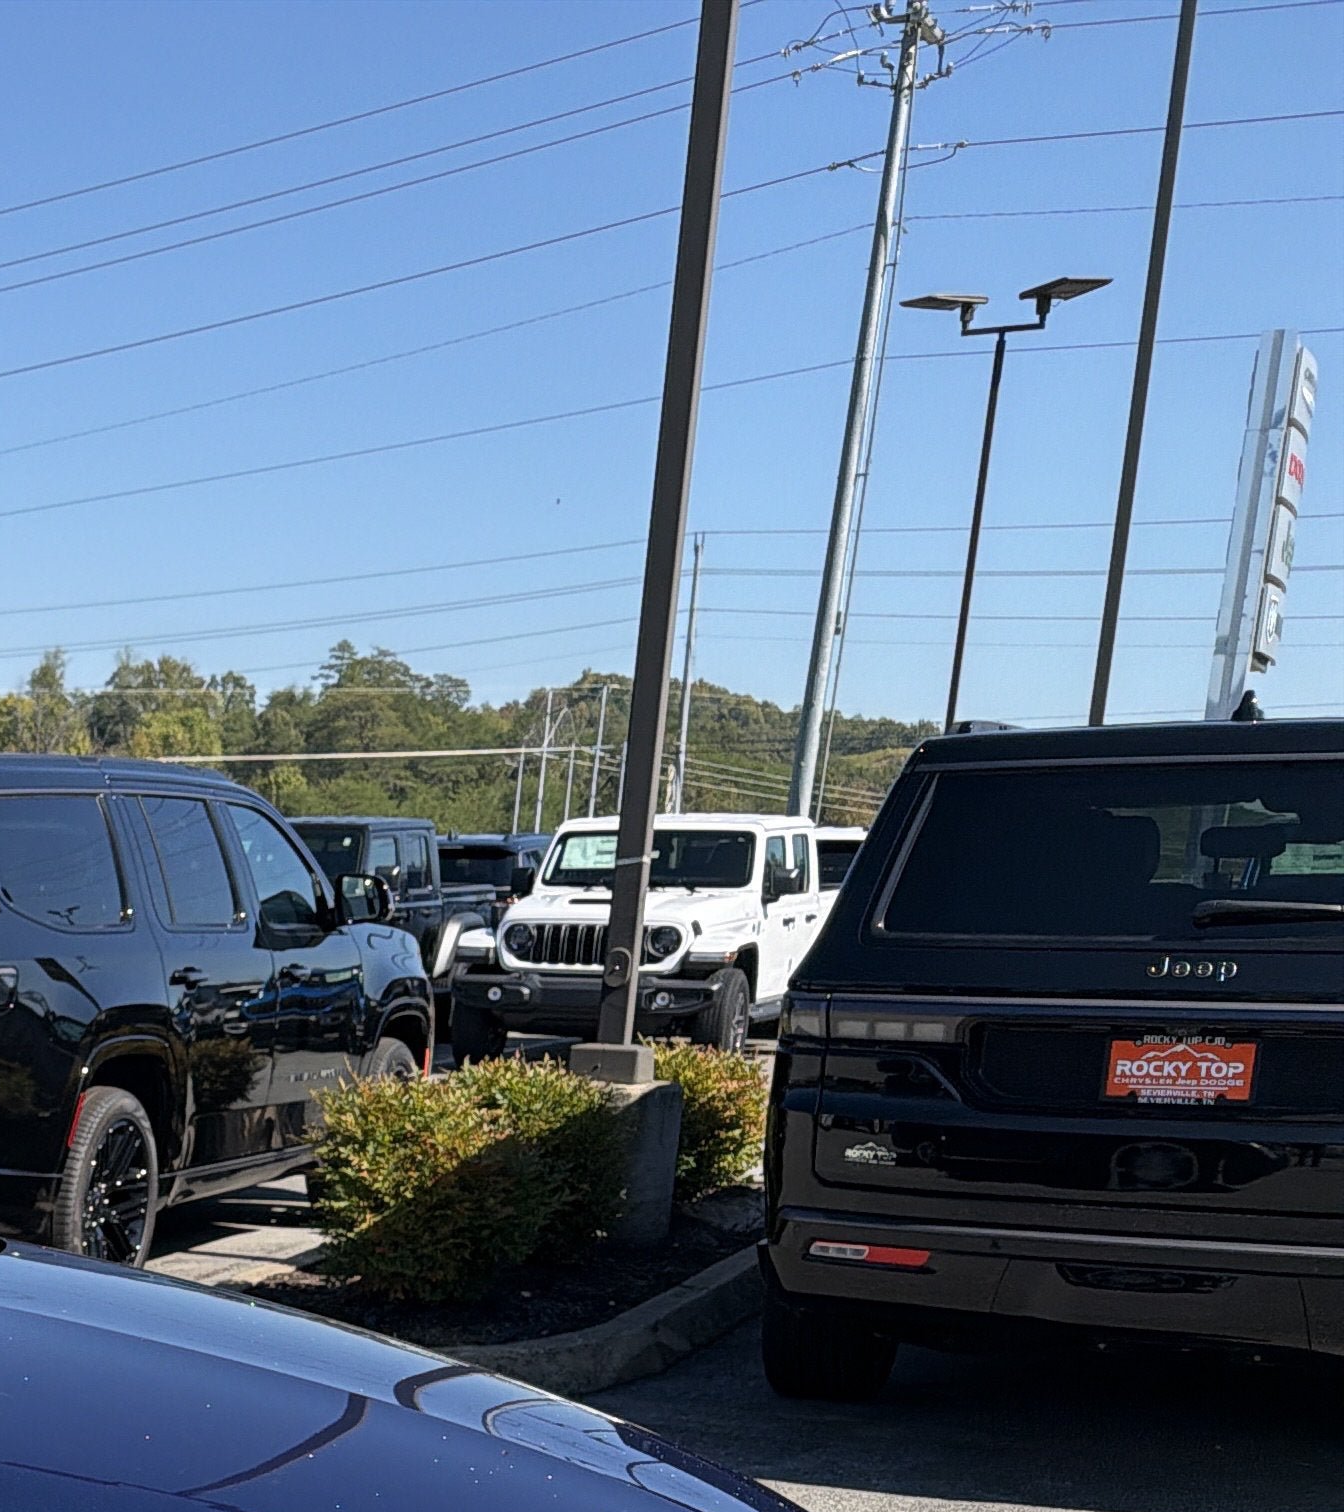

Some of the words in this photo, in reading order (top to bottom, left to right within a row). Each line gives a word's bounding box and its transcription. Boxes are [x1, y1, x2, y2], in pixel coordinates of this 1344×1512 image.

[1145, 955, 1239, 982] Jeep
[1143, 1034, 1178, 1045] ROCKY
[1115, 1059, 1193, 1078] ROCKY
[1197, 1061, 1246, 1079] TOP
[1113, 1077, 1174, 1086] CHRYSLER
[1176, 1078, 1198, 1087] Jeep
[1199, 1079, 1245, 1087] DODGE
[1202, 1090, 1216, 1098] TN
